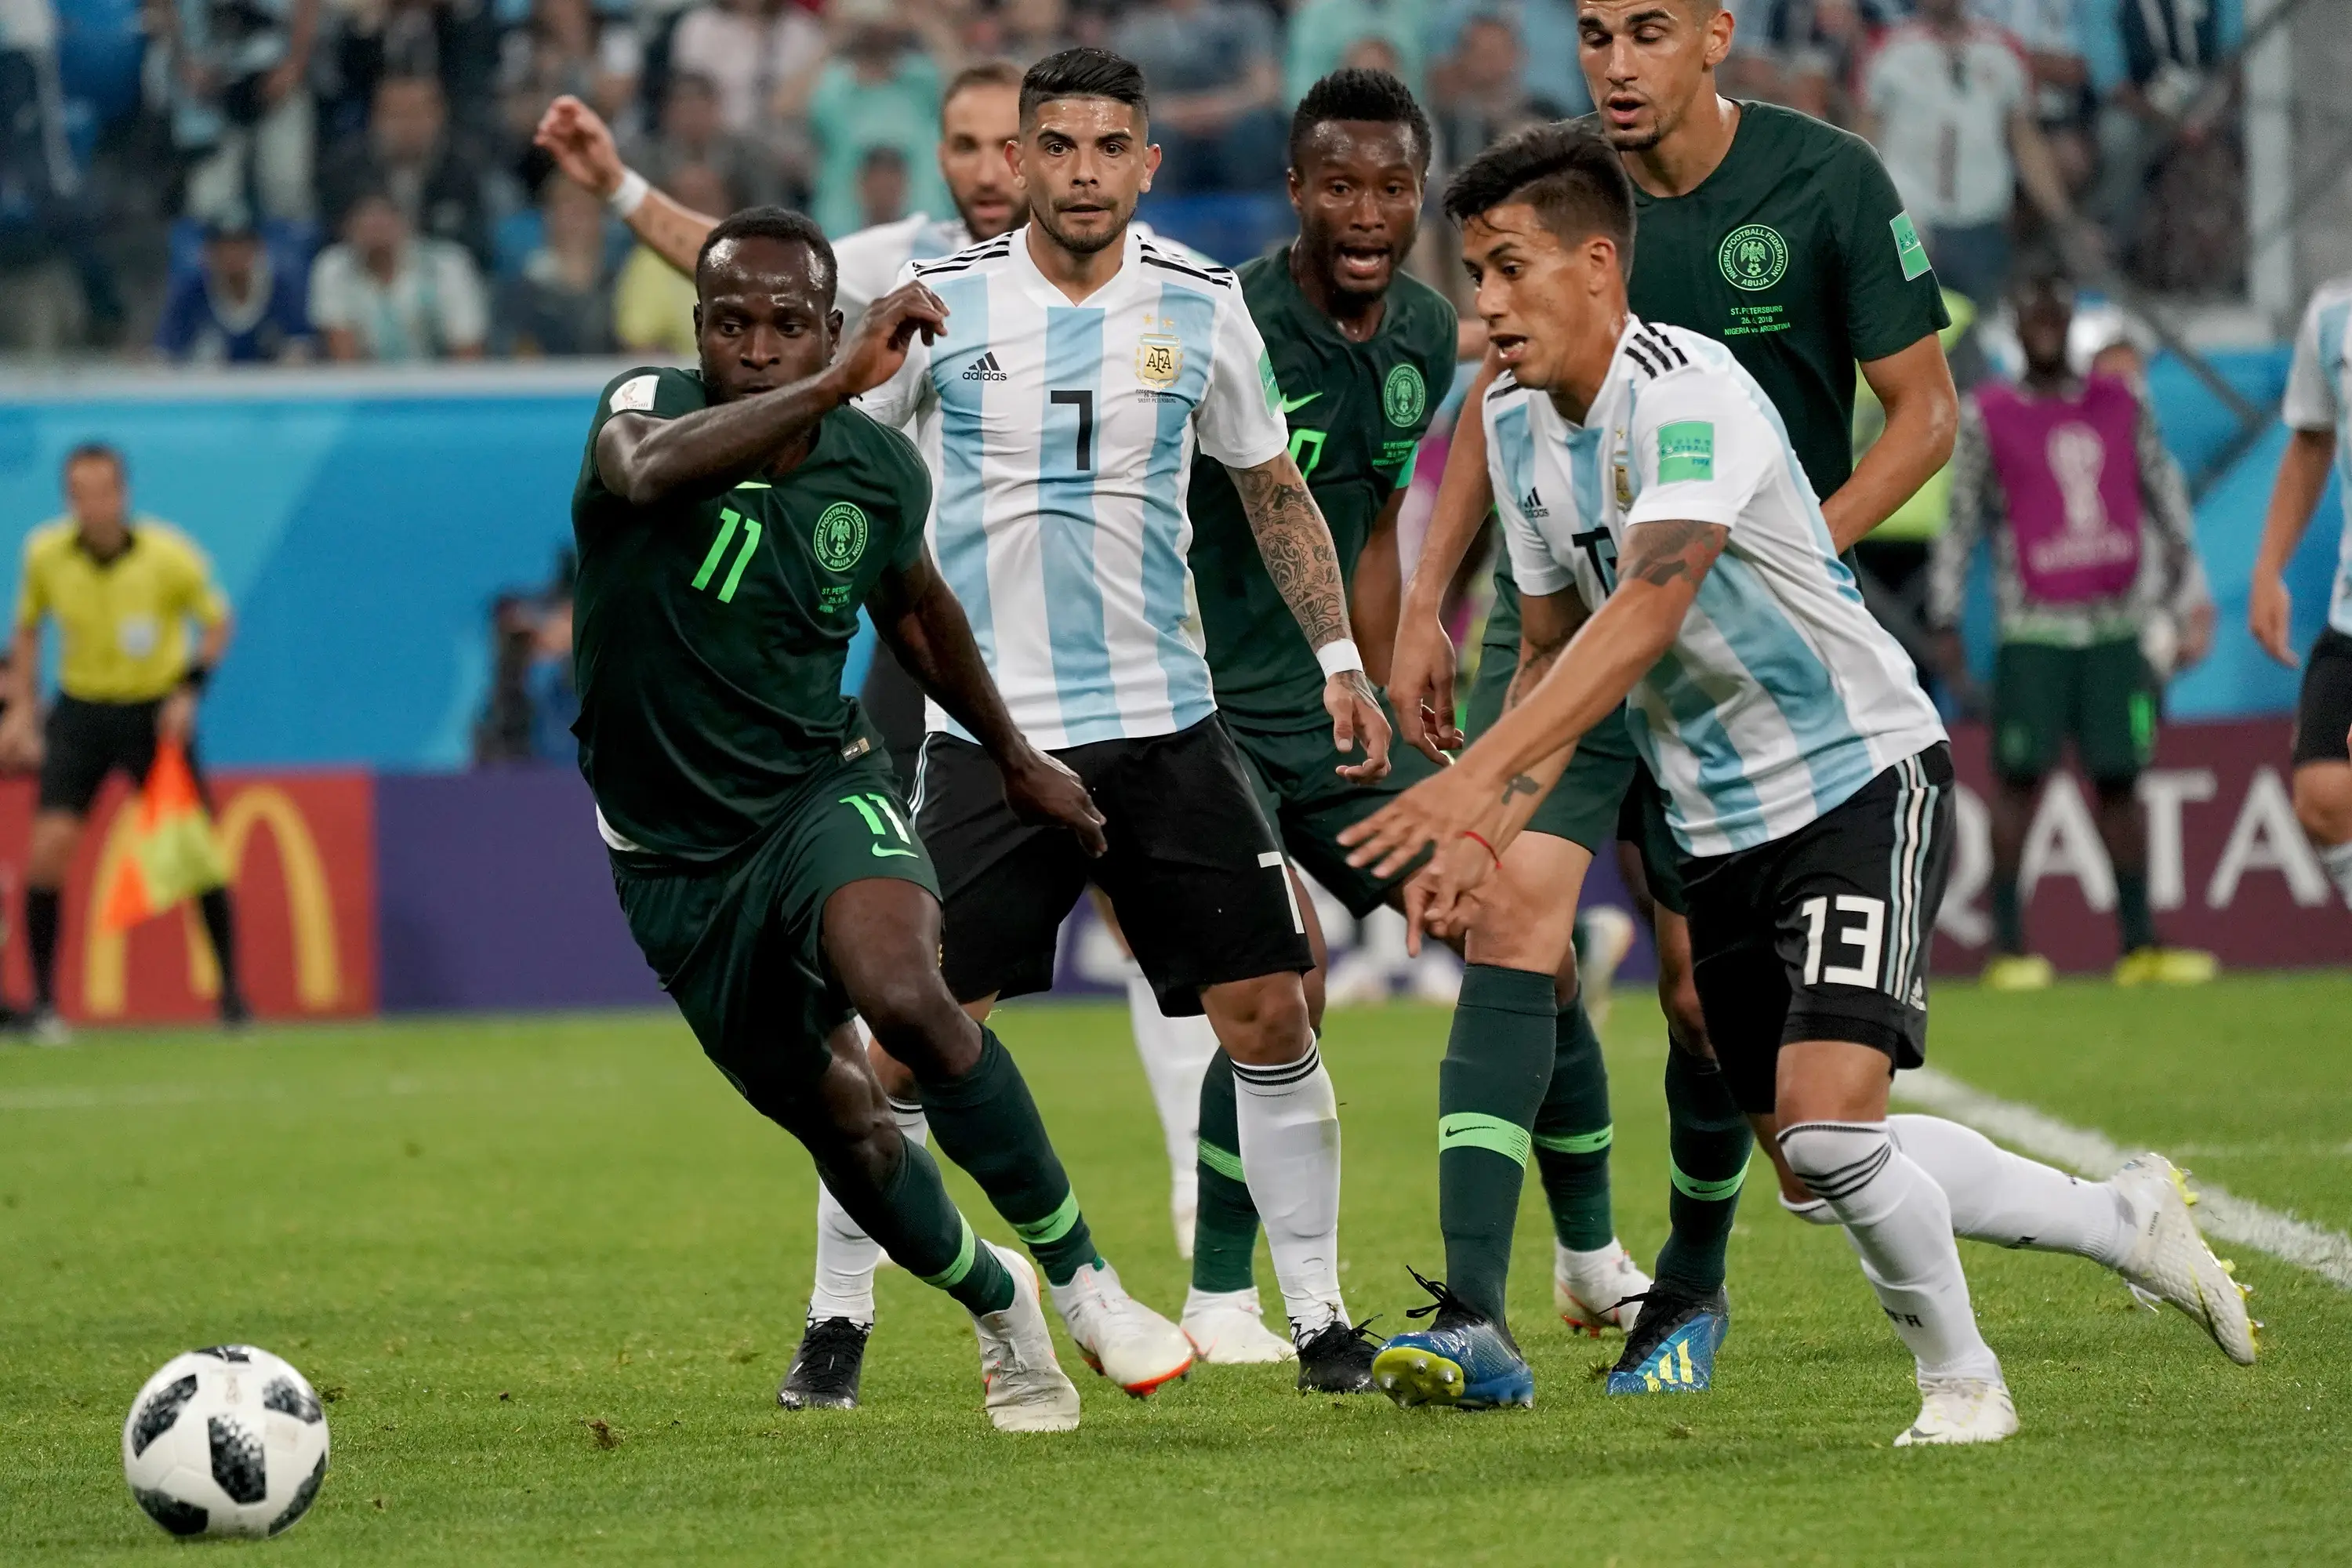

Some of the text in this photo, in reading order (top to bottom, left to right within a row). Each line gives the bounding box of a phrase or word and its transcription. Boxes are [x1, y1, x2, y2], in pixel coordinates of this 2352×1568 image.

[1723, 228, 1785, 280] NIGERIA FOOTBALL FEDERATION
[1740, 277, 1770, 288] ABUJA
[1724, 326, 1751, 336] NIGERIA
[1759, 321, 1791, 333] ARGENTINA
[962, 368, 1007, 381] adidas
[1146, 346, 1173, 374] AFA
[1051, 390, 1093, 470] 7
[691, 506, 762, 604] 11
[820, 506, 851, 528] FOOTBALL
[851, 510, 864, 557] FEDERATION
[839, 793, 911, 844] 11
[1258, 851, 1305, 934] 7
[1802, 895, 1886, 989] 13
